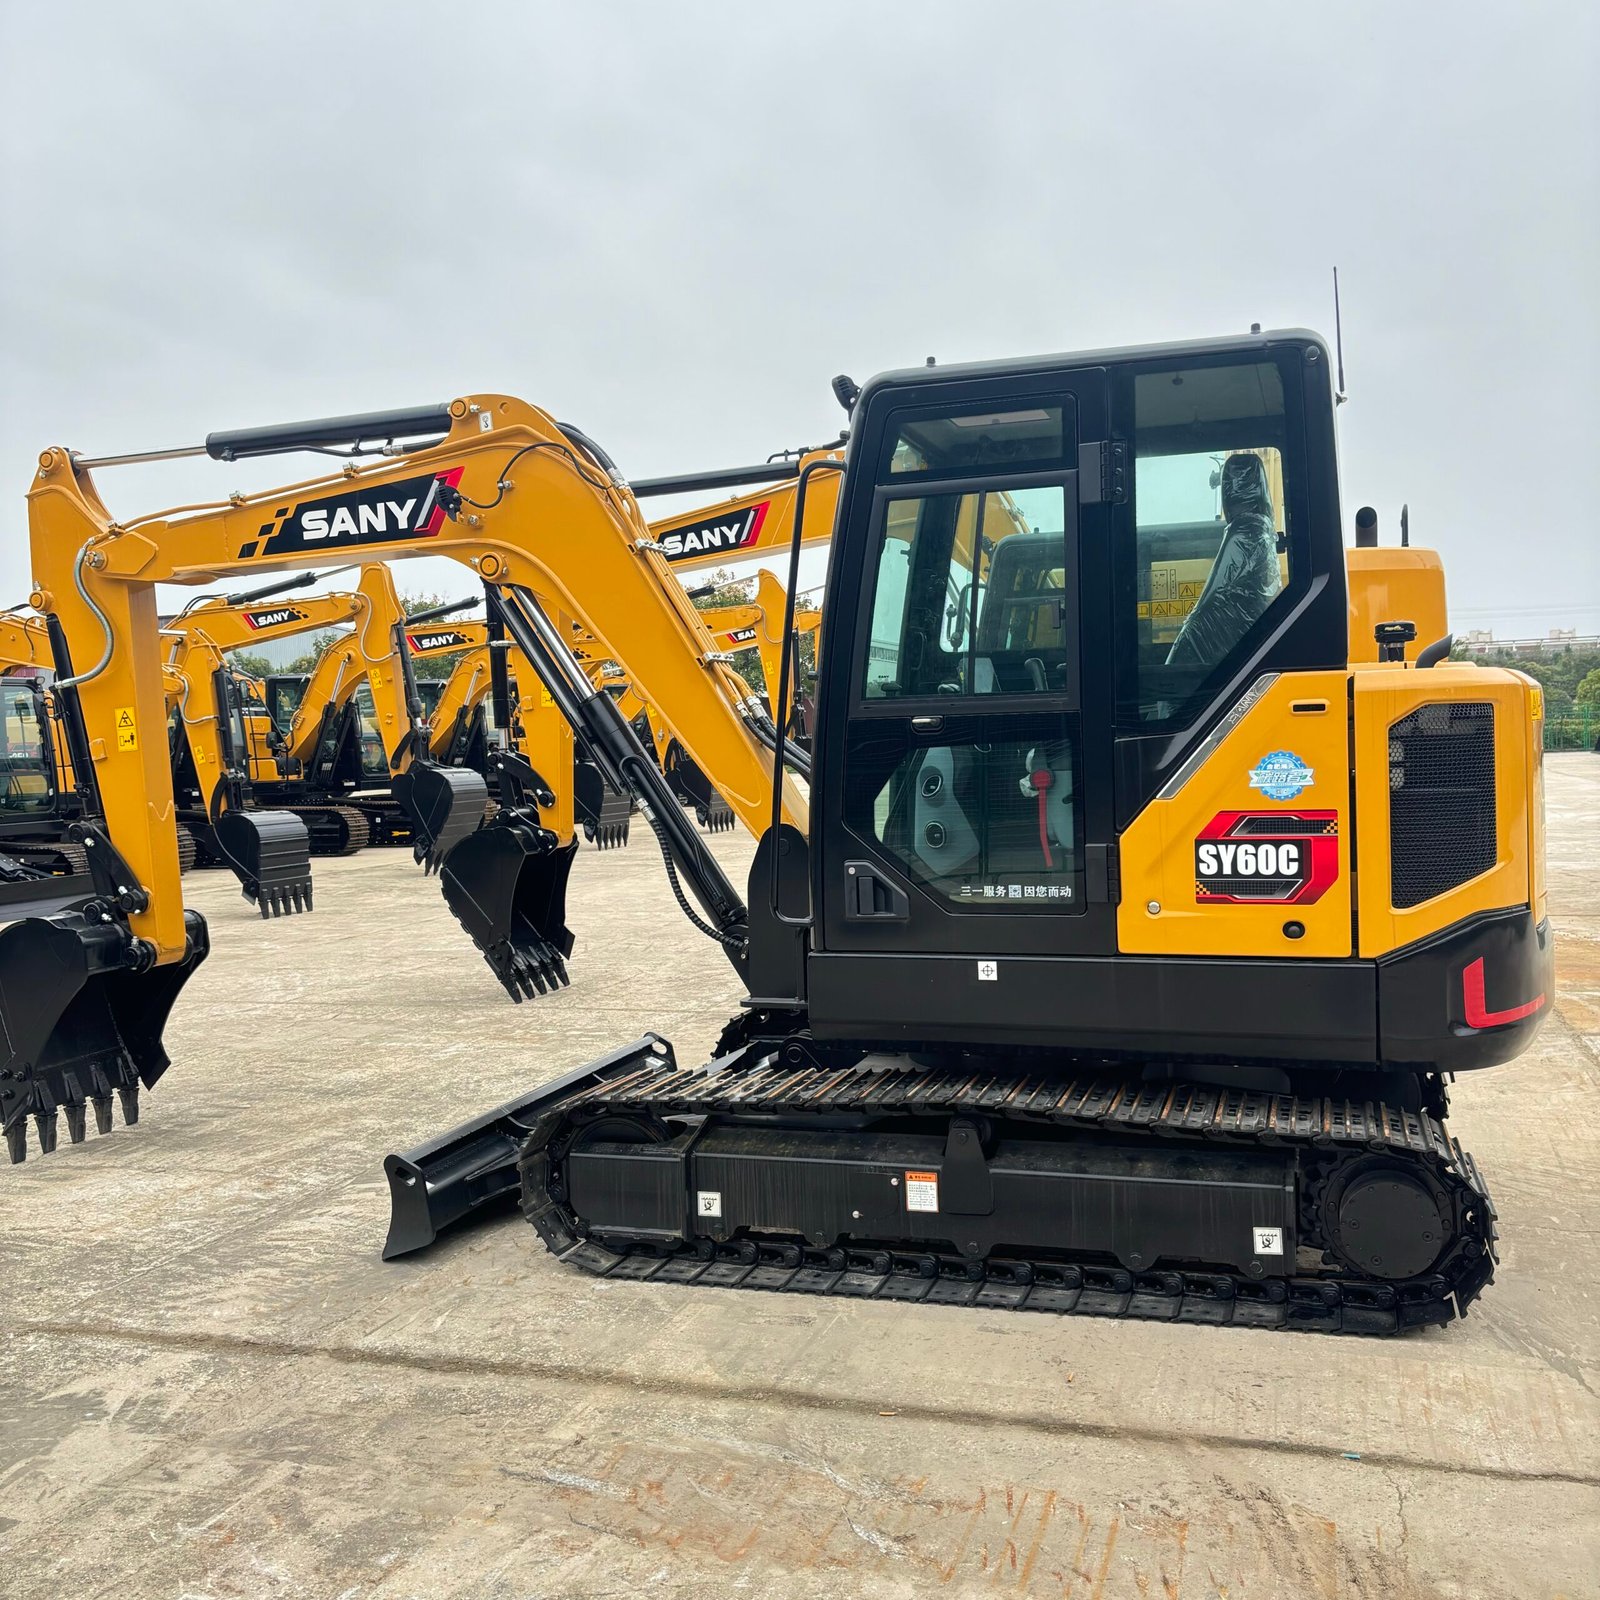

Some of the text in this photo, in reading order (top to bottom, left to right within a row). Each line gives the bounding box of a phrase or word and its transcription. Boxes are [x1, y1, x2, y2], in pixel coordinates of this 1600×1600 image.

[301, 498, 417, 540] SANY
[664, 523, 741, 556] SANY
[257, 610, 290, 626] SANY
[421, 634, 455, 648] SANY
[1198, 844, 1299, 876] SY60C
[960, 885, 1072, 898] 三一服务 因您而动
